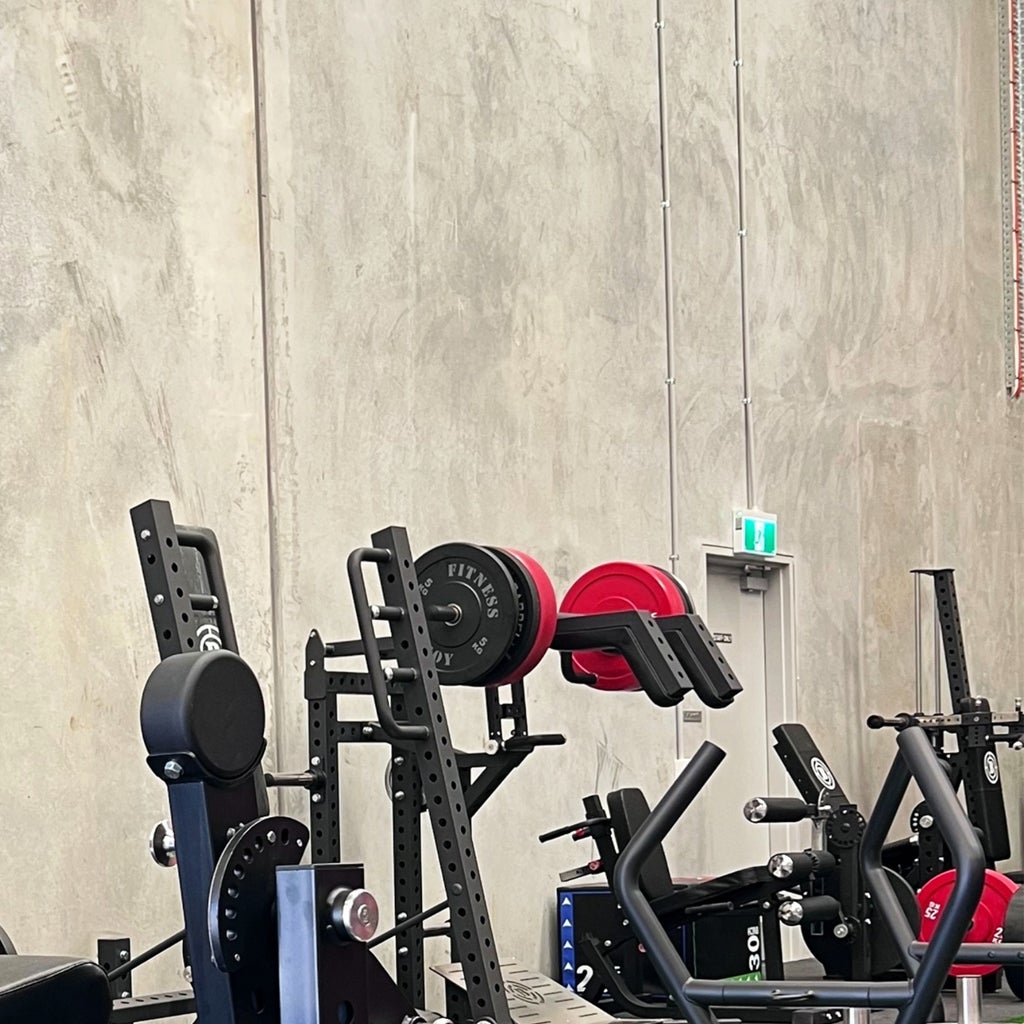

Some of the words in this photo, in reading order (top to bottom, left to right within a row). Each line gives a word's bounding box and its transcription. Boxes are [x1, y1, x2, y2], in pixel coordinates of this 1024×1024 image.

[424, 577, 433, 588] 5
[447, 563, 499, 618] FITNESS
[471, 641, 484, 655] KG
[478, 636, 488, 646] 5
[431, 650, 454, 666] OY
[924, 907, 939, 920] 25
[747, 935, 760, 970] 30
